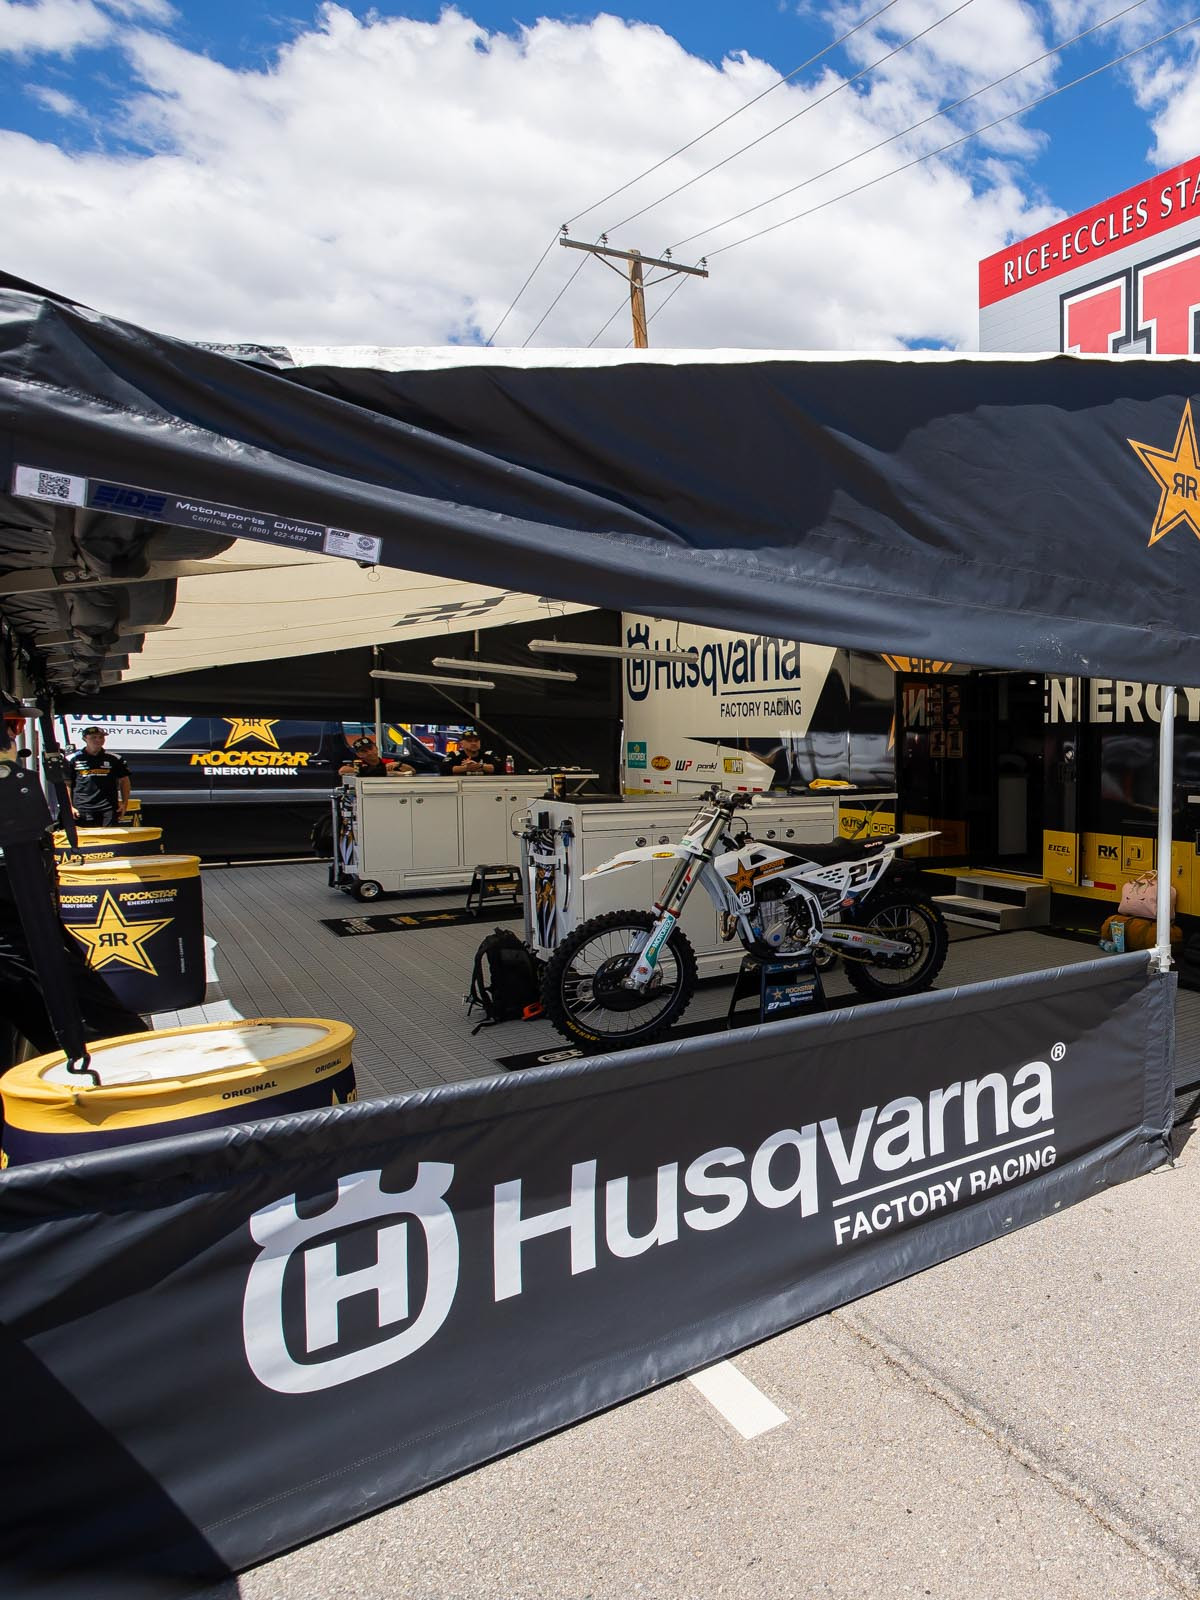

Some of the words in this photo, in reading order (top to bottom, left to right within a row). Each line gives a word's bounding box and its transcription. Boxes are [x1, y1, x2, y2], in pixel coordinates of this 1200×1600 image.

[1003, 198, 1148, 287] RICE-ECCLES
[175, 501, 265, 526] Motorsports
[273, 521, 323, 537] Division
[231, 522, 243, 530] CA
[249, 525, 270, 536] (800)
[720, 701, 761, 718] FACTORY
[763, 699, 802, 717] RACING
[126, 728, 168, 736] RACING
[190, 751, 309, 767] ROCKSTAR
[203, 767, 258, 776] ENERGY
[258, 767, 298, 776] DRINK
[1097, 845, 1119, 858] RK
[849, 858, 885, 888] 27
[119, 889, 178, 902] ROCKSTAR
[221, 1080, 278, 1100] ORIGINAL
[314, 1058, 342, 1075] ORIGINAL
[493, 1061, 1055, 1302] Husqvarna
[833, 1177, 963, 1246] FACTORY
[969, 1145, 1057, 1196] RACING
